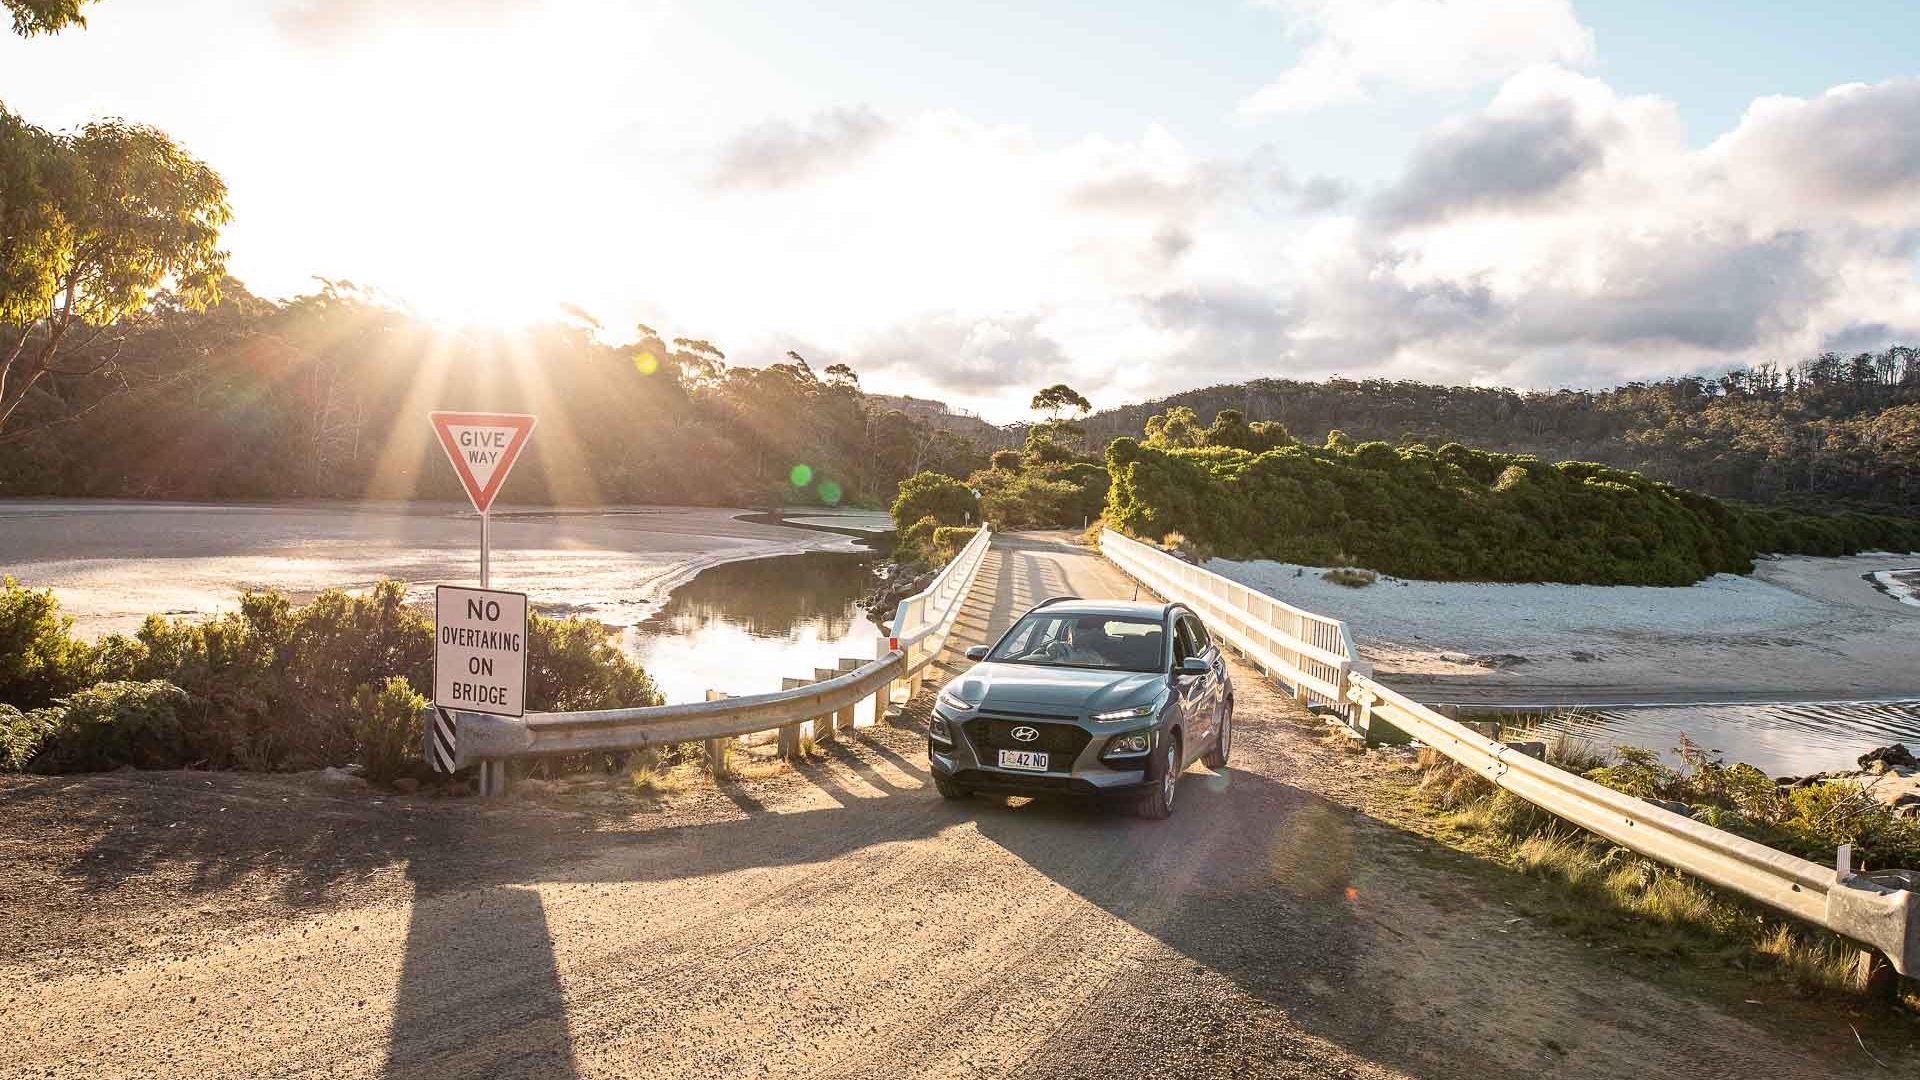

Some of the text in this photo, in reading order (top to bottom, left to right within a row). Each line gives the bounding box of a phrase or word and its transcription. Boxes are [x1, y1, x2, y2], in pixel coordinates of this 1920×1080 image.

[460, 431, 505, 448] GIVE
[468, 450, 498, 464] WAY
[467, 598, 500, 621] NO
[442, 626, 520, 652] OVERTAKING
[468, 656, 493, 676] ON
[452, 681, 508, 706] BRIDGE
[1016, 753, 1030, 766] 42
